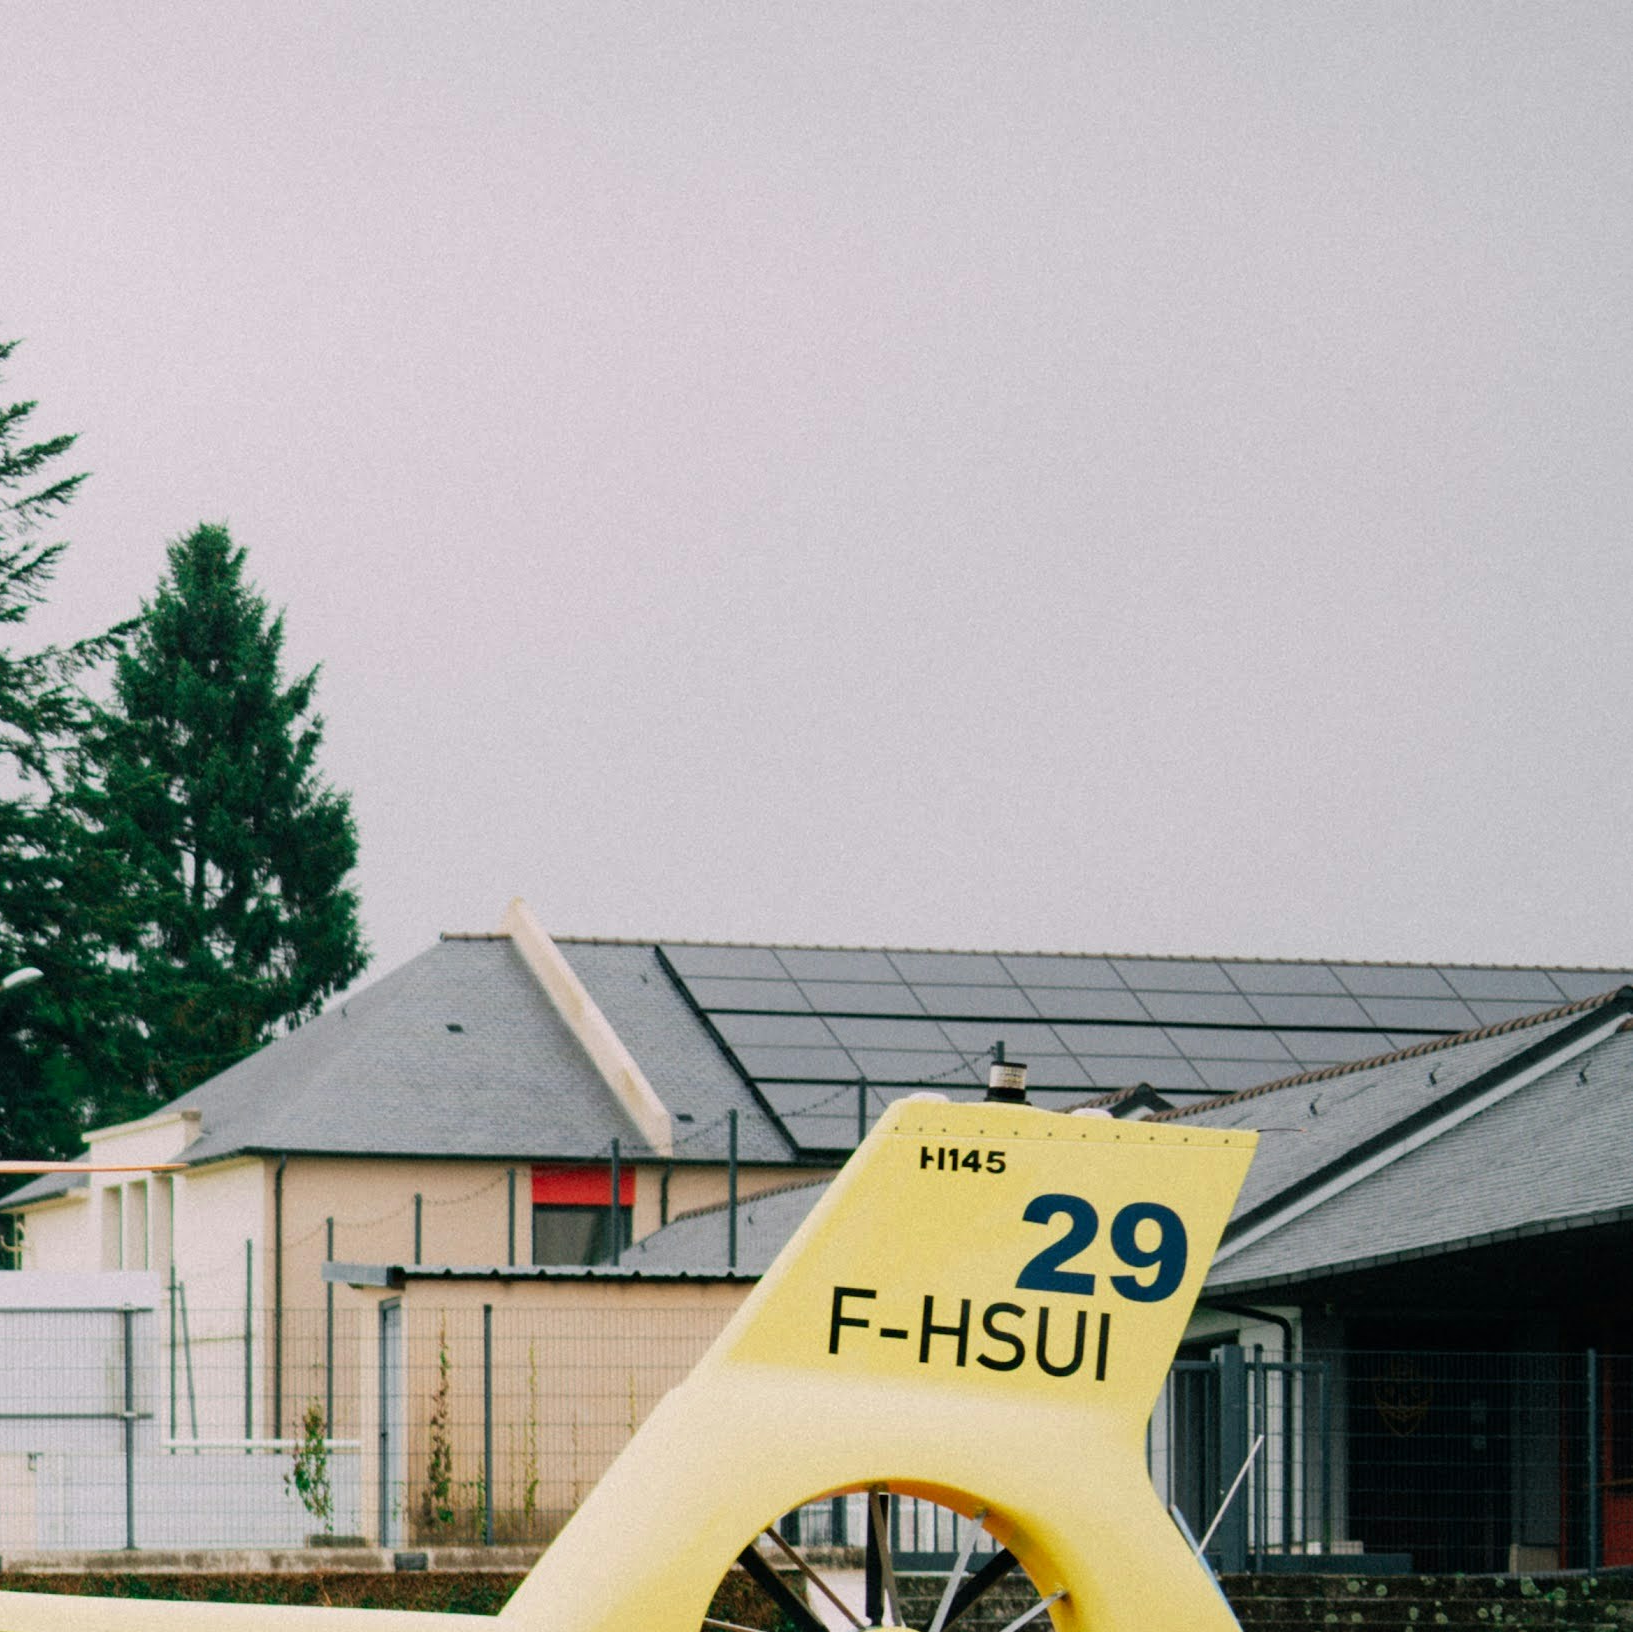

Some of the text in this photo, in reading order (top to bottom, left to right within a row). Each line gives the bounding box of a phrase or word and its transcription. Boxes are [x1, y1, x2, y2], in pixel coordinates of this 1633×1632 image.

[919, 1146, 1007, 1174] H145
[1014, 1193, 1188, 1303] 29
[828, 1286, 1111, 1382] F-HSUI
